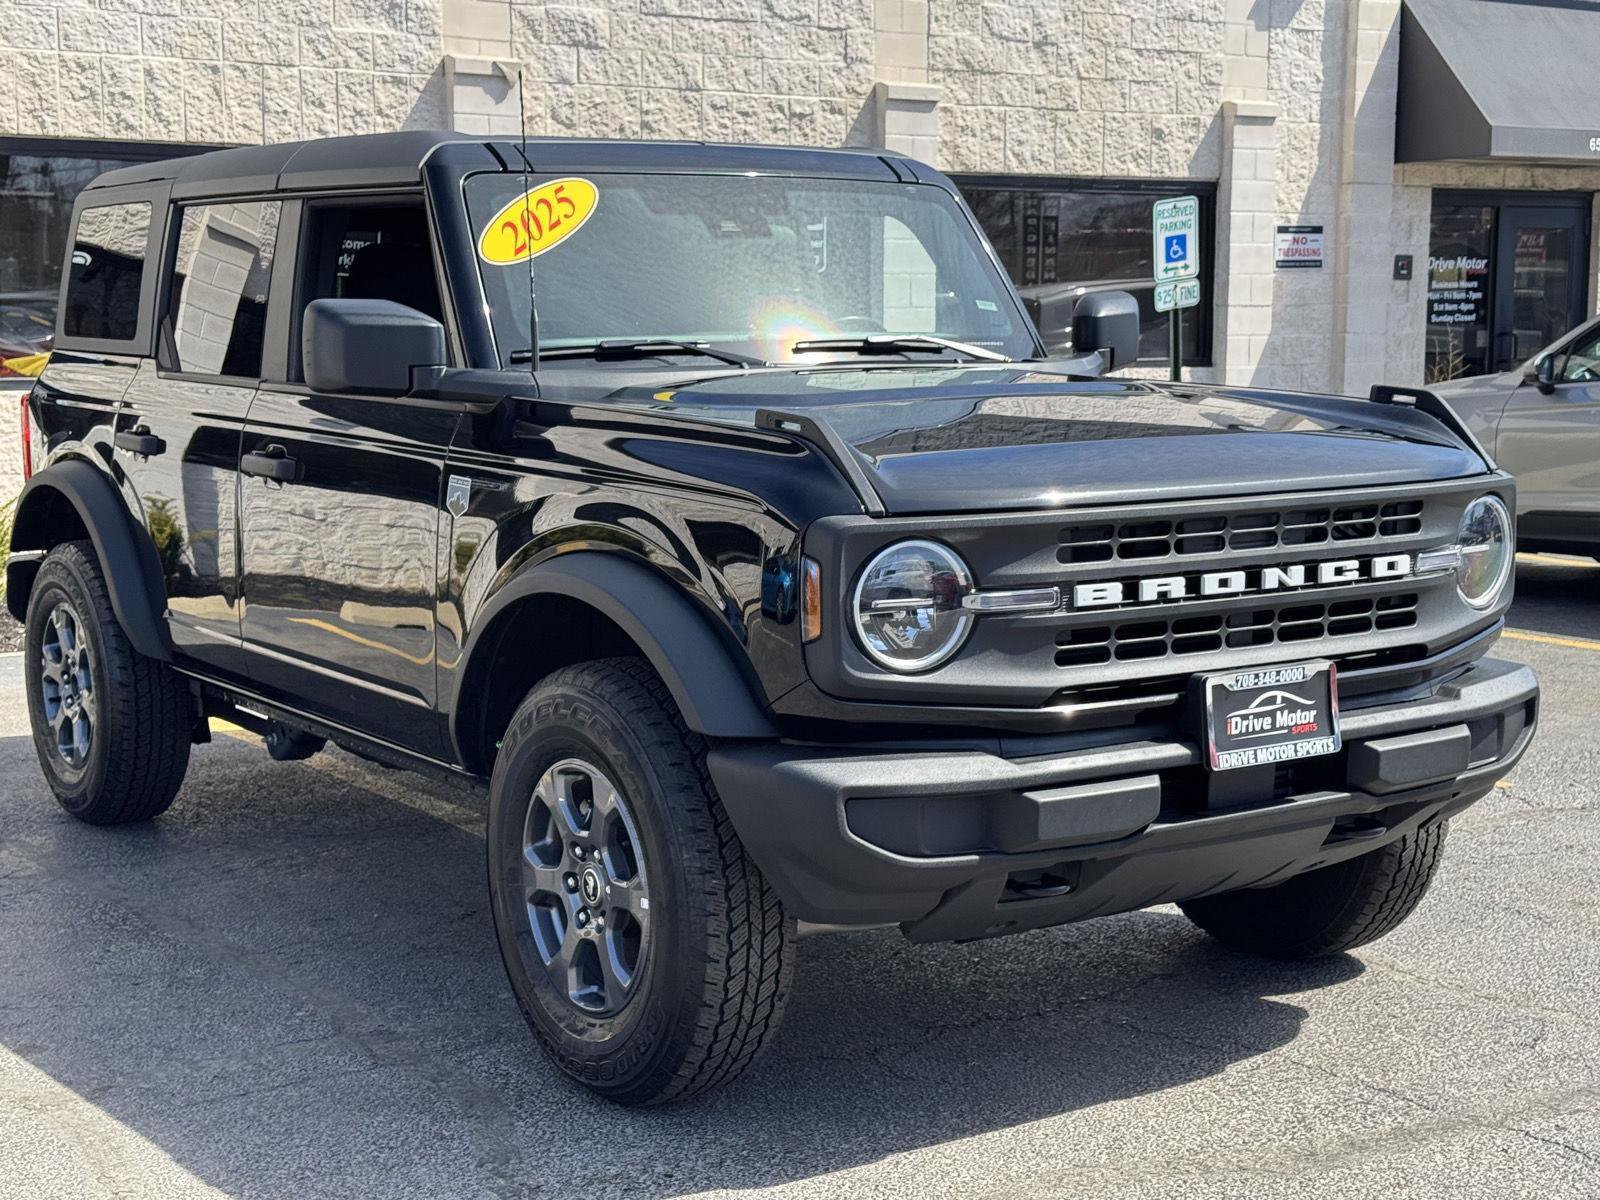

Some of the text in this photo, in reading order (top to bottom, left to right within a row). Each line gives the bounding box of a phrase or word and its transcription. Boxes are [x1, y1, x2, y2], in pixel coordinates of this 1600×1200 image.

[1157, 204, 1194, 220] RESERVED
[501, 184, 576, 257] 2025
[1159, 219, 1192, 233] PARKING
[1292, 236, 1308, 246] NO
[1278, 247, 1321, 257] TRESPASSING
[1457, 256, 1488, 269] Motor
[1180, 285, 1198, 301] FINE
[1073, 553, 1412, 608] BRONCO
[1236, 667, 1304, 689] 708-348-0000
[1226, 708, 1317, 736] iDrive Motor
[1290, 722, 1318, 735] SPORTS
[1256, 743, 1296, 762] MOTOR
[1297, 736, 1335, 755] SPORTS
